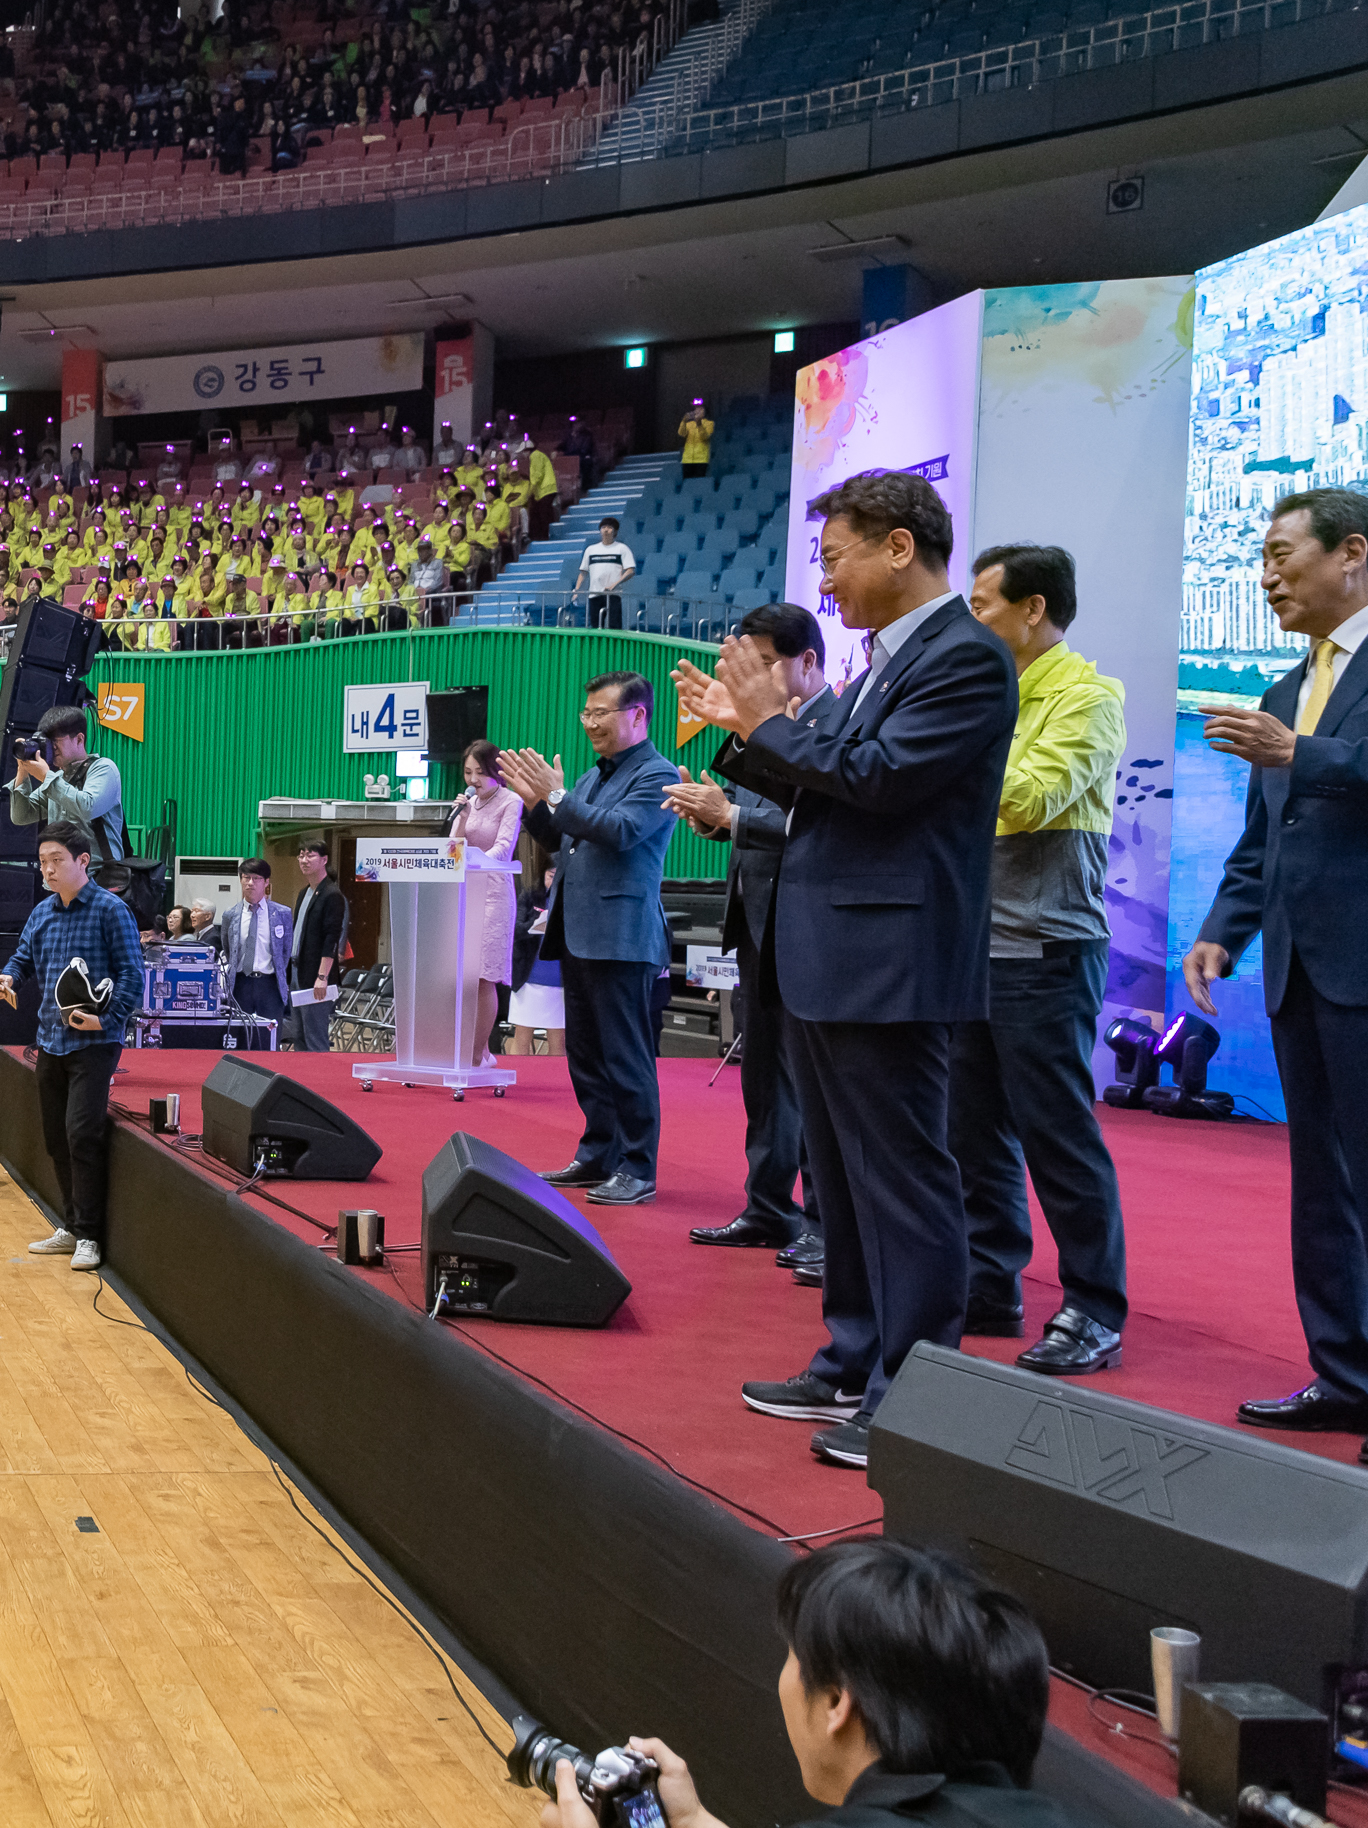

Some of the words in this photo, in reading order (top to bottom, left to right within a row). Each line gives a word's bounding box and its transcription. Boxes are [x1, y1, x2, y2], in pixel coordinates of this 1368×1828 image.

[234, 356, 326, 394] 강동구
[440, 367, 469, 394] 15
[65, 394, 93, 418] 15
[103, 695, 139, 721] S7
[366, 858, 382, 866] 2019
[383, 858, 455, 870] 서울시민체육대축전
